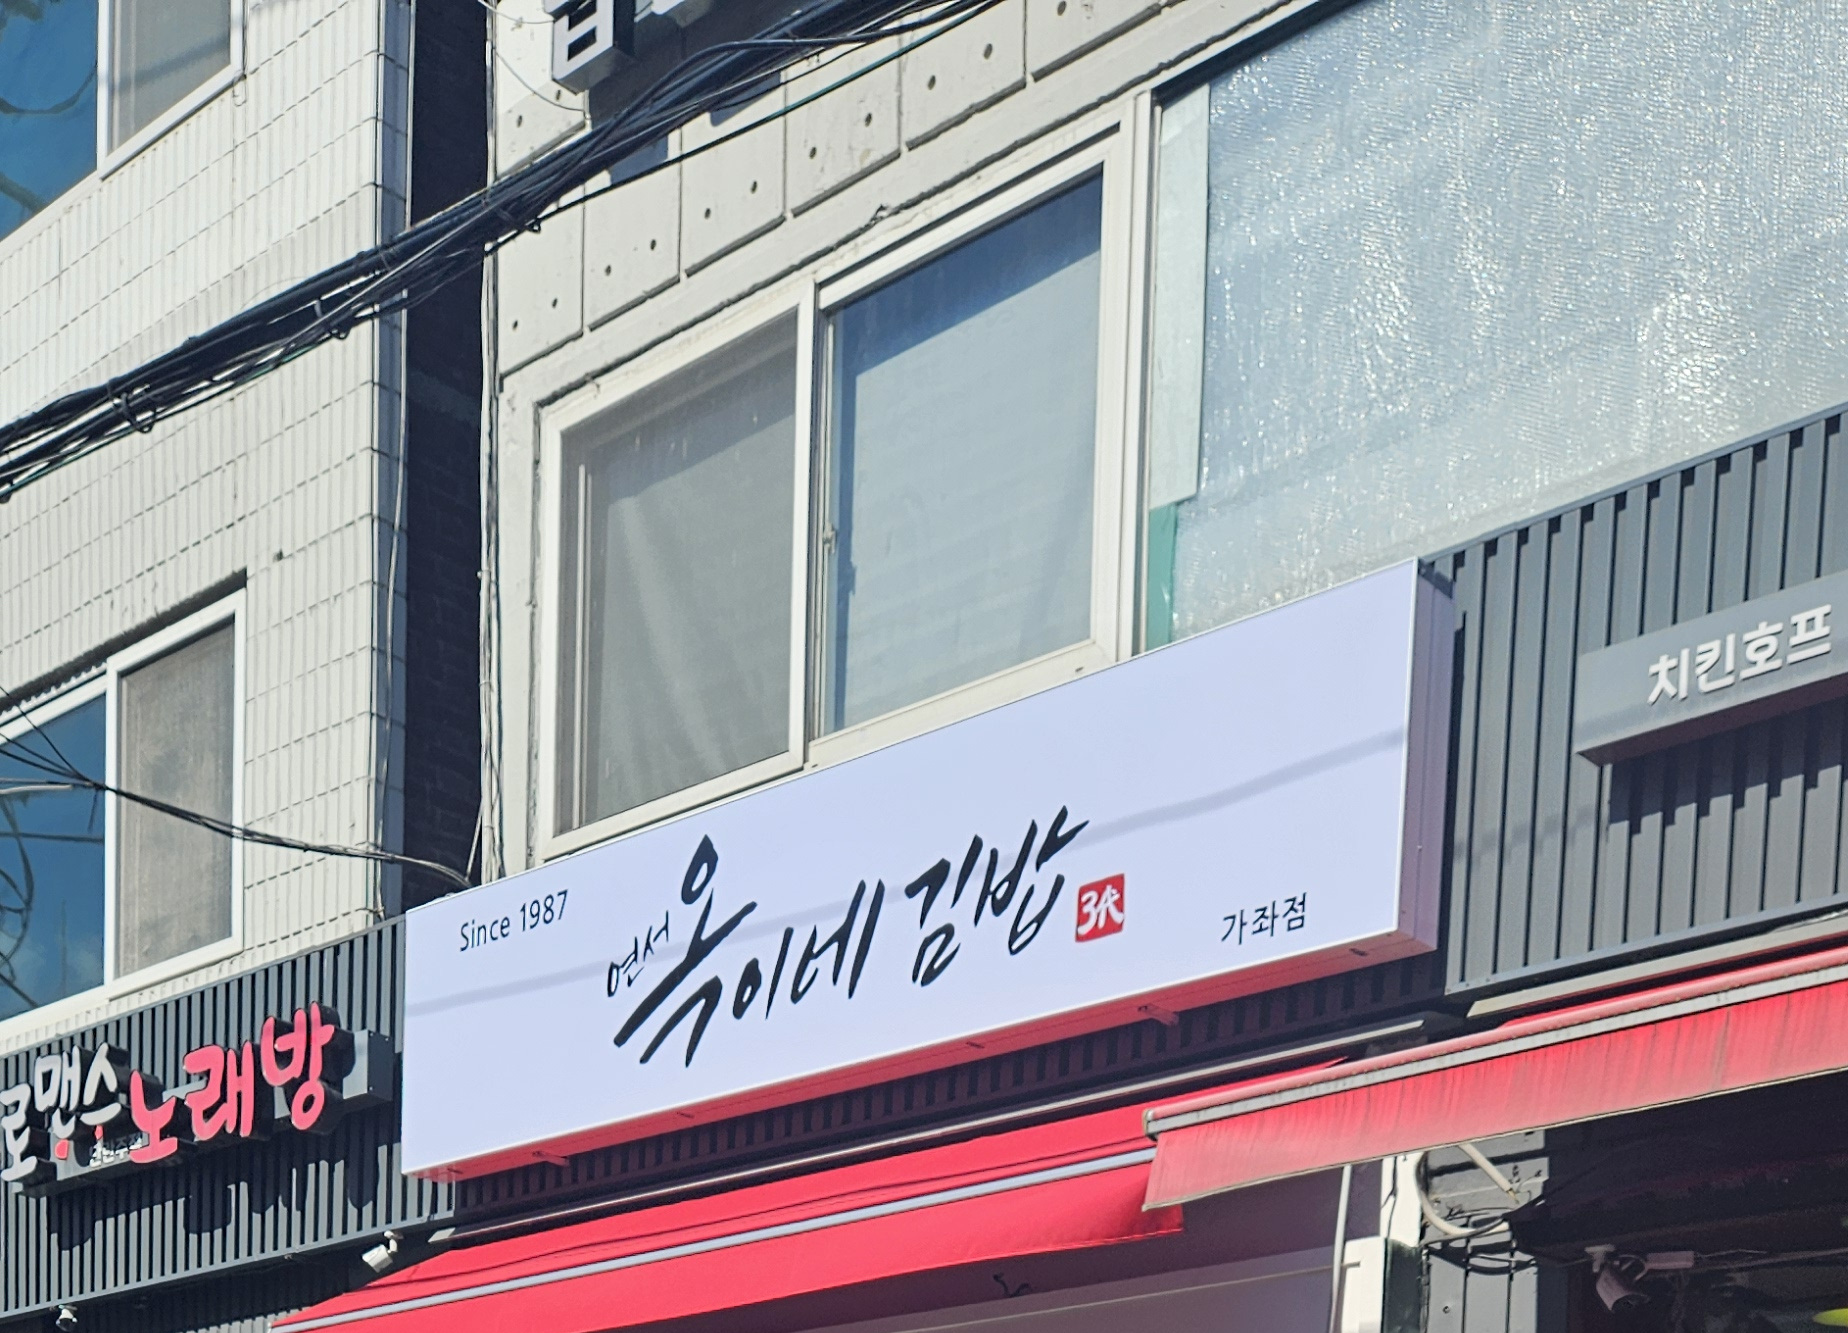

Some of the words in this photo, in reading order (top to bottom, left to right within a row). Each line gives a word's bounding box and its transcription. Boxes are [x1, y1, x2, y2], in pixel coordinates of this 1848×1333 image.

[1647, 604, 1832, 705] 치킨호프
[459, 915, 511, 953] Since
[518, 889, 570, 933] 1987
[903, 804, 1091, 987] 김밥
[1221, 892, 1308, 946] 가좌점
[607, 911, 671, 997] 연서
[613, 834, 885, 1068] 옥이네
[130, 1001, 335, 1164] 노래방
